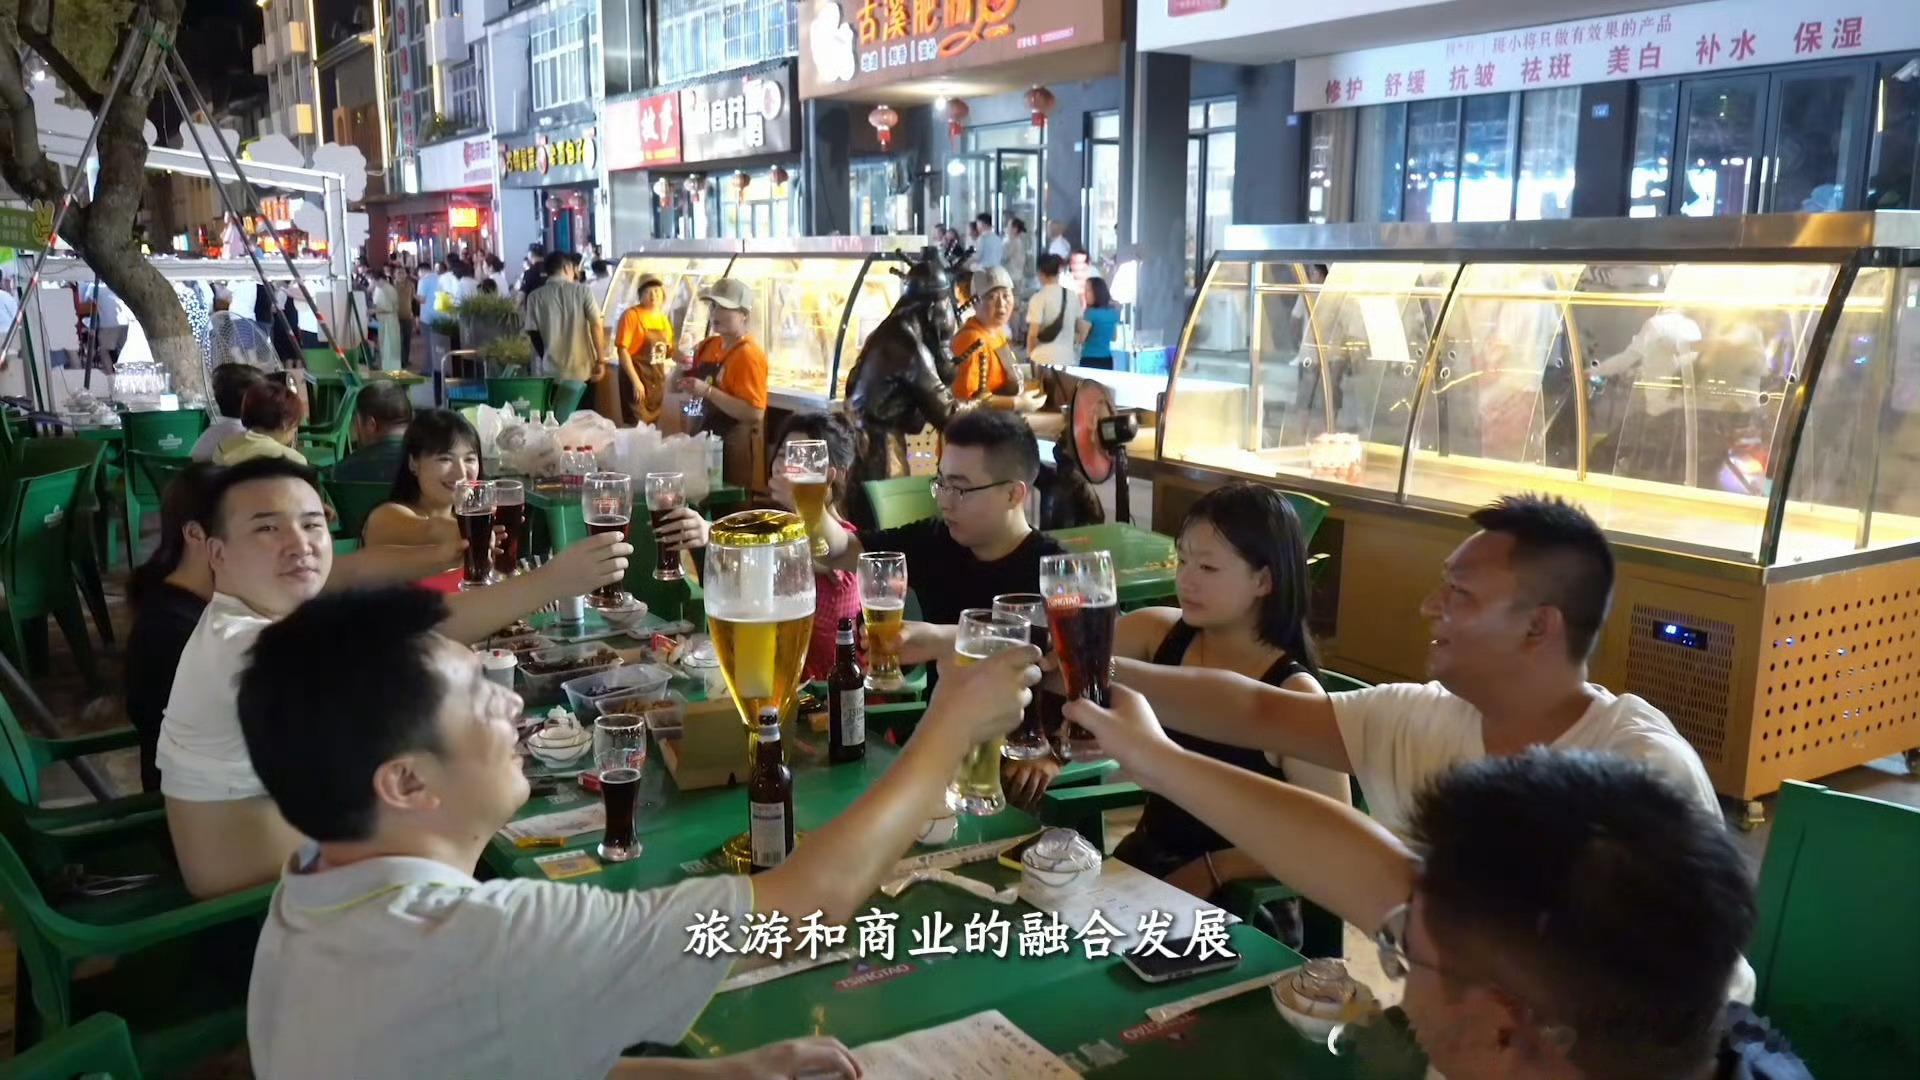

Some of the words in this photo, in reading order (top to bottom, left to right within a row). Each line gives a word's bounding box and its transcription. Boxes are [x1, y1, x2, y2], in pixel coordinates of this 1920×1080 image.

[1493, 13, 1672, 53] 斑小将只做有效果的产品
[1325, 76, 1363, 104] 修护
[1384, 69, 1425, 97] 舒缓
[1449, 61, 1495, 90] 抗皱
[1521, 53, 1570, 84] 祛斑
[1607, 41, 1661, 75] 美白
[1695, 29, 1756, 65] 补水
[1793, 16, 1863, 54] 保湿
[836, 963, 910, 989] TSINGTAO
